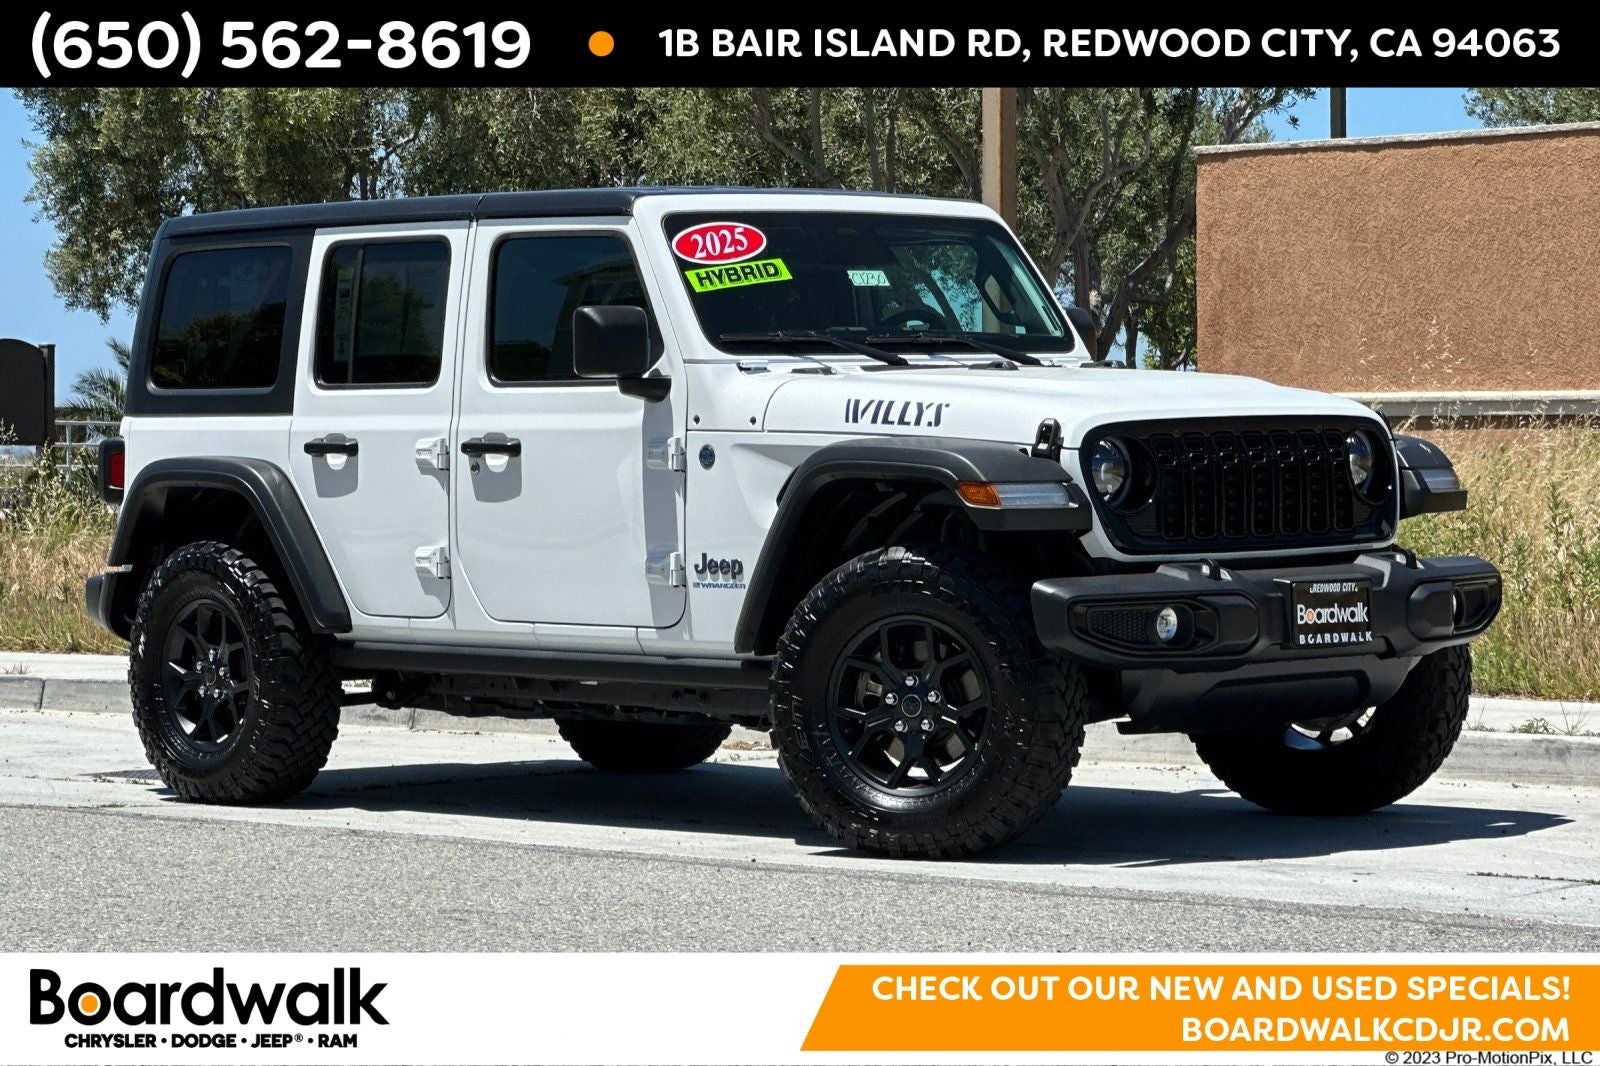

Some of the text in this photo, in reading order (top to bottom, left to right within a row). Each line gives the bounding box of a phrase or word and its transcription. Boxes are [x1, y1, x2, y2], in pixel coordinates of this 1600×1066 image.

[690, 227, 748, 259] 2025
[697, 262, 780, 288] HYBRID
[845, 399, 949, 427] WILLYS
[694, 553, 743, 579] Jeep
[1312, 582, 1356, 593] REDWOOD CITY
[1297, 602, 1369, 625] Boardwalk
[1299, 631, 1372, 645] BOARDWALK
